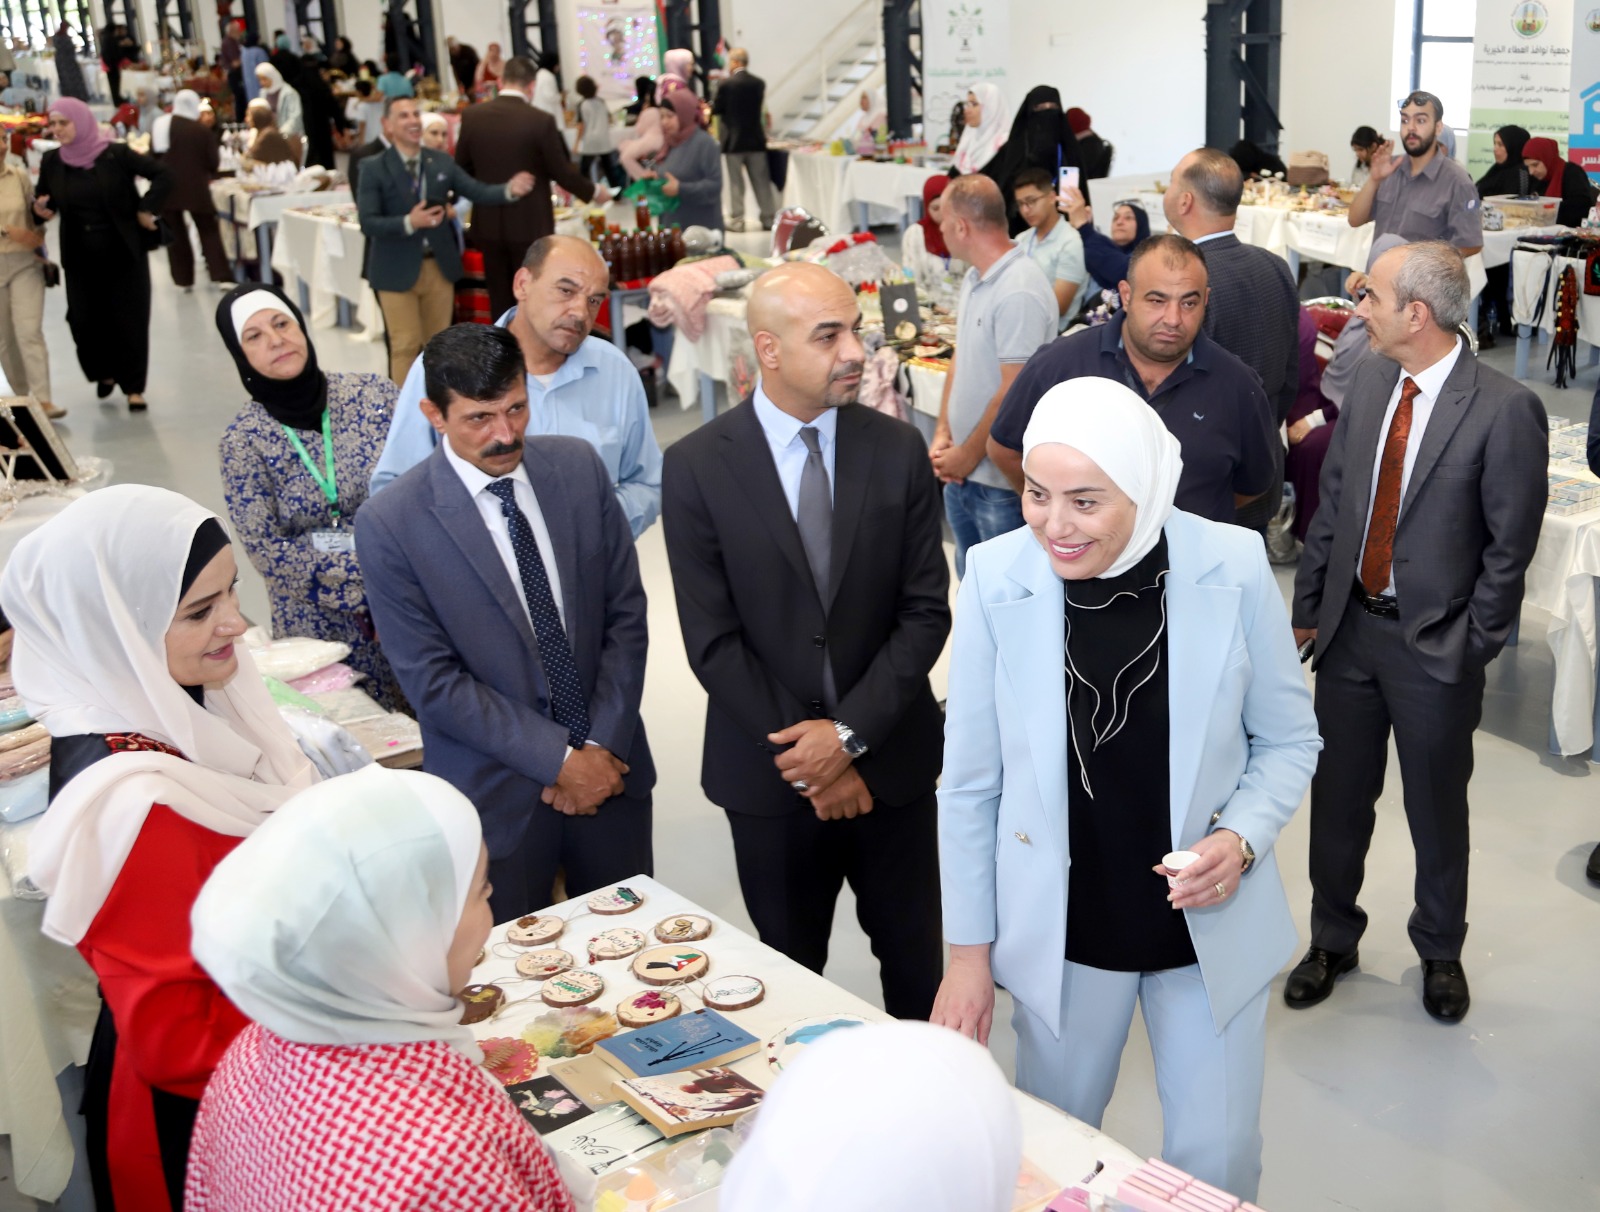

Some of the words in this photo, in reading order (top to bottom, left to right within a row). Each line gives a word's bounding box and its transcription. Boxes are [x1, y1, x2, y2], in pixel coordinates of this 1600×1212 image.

[1483, 44, 1506, 56] الخيرية
[1508, 44, 1529, 54] العطاء
[1530, 45, 1549, 56] نوافذ
[1550, 45, 1570, 57] جمعية
